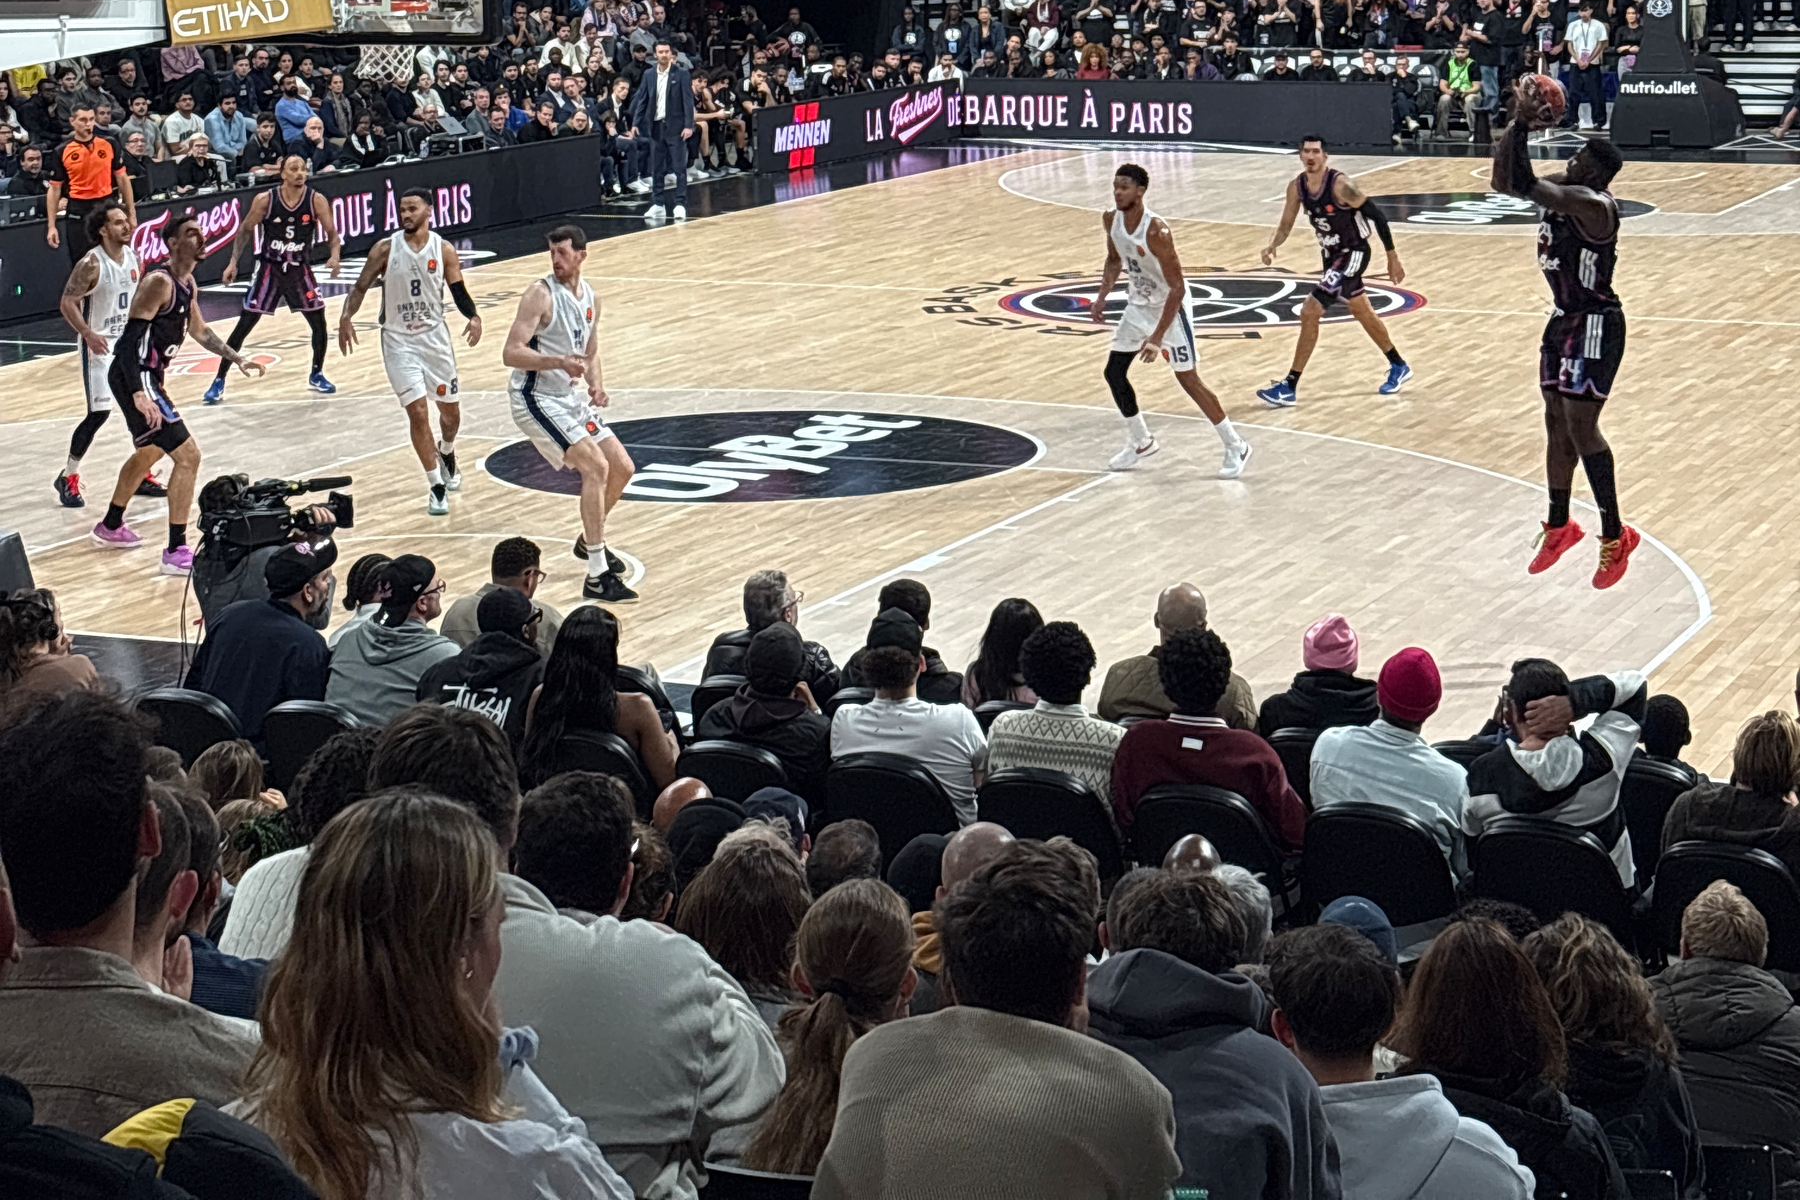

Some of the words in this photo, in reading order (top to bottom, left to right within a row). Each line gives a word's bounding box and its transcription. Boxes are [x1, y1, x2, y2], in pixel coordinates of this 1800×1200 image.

[866, 108, 884, 142] LA
[889, 86, 943, 140] Freshness
[1080, 88, 1099, 127] À
[1110, 102, 1193, 134] PARIS
[774, 118, 831, 154] MENNEN
[430, 183, 473, 230] ARIS
[285, 225, 295, 239] 5
[270, 240, 306, 254] OlyBet
[410, 279, 421, 297] 8
[1170, 345, 1189, 363] 15
[621, 414, 923, 499] OlyBet
